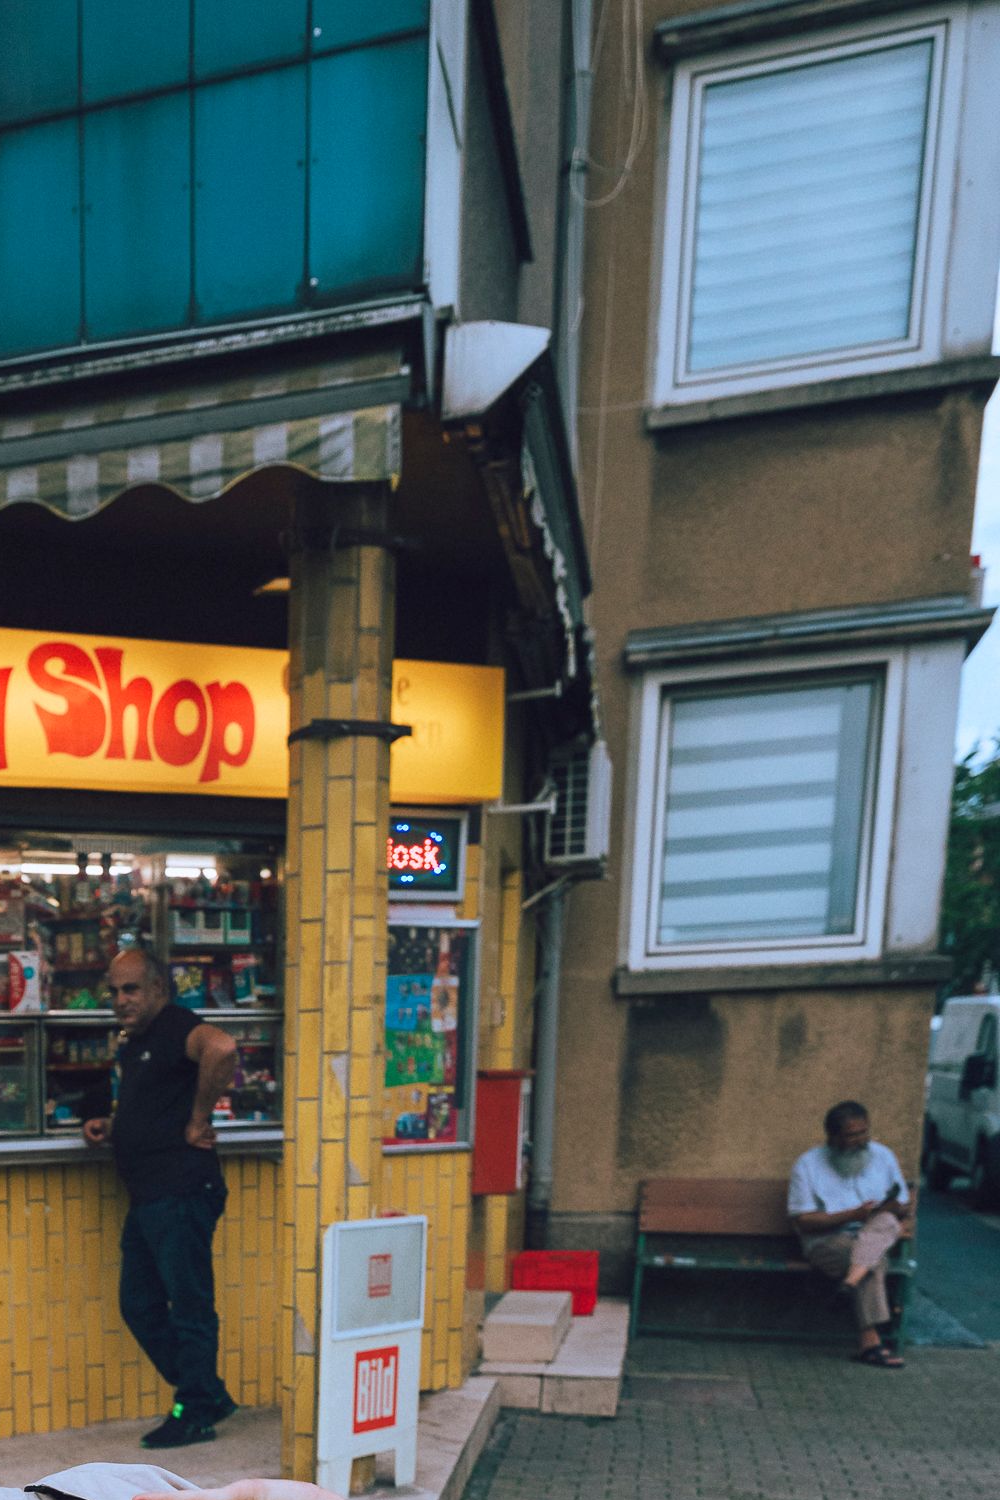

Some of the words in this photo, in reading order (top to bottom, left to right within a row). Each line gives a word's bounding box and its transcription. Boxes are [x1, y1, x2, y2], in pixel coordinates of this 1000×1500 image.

[27, 641, 255, 783] Shop
[386, 837, 439, 875] iosk
[356, 1353, 397, 1424] Bild
